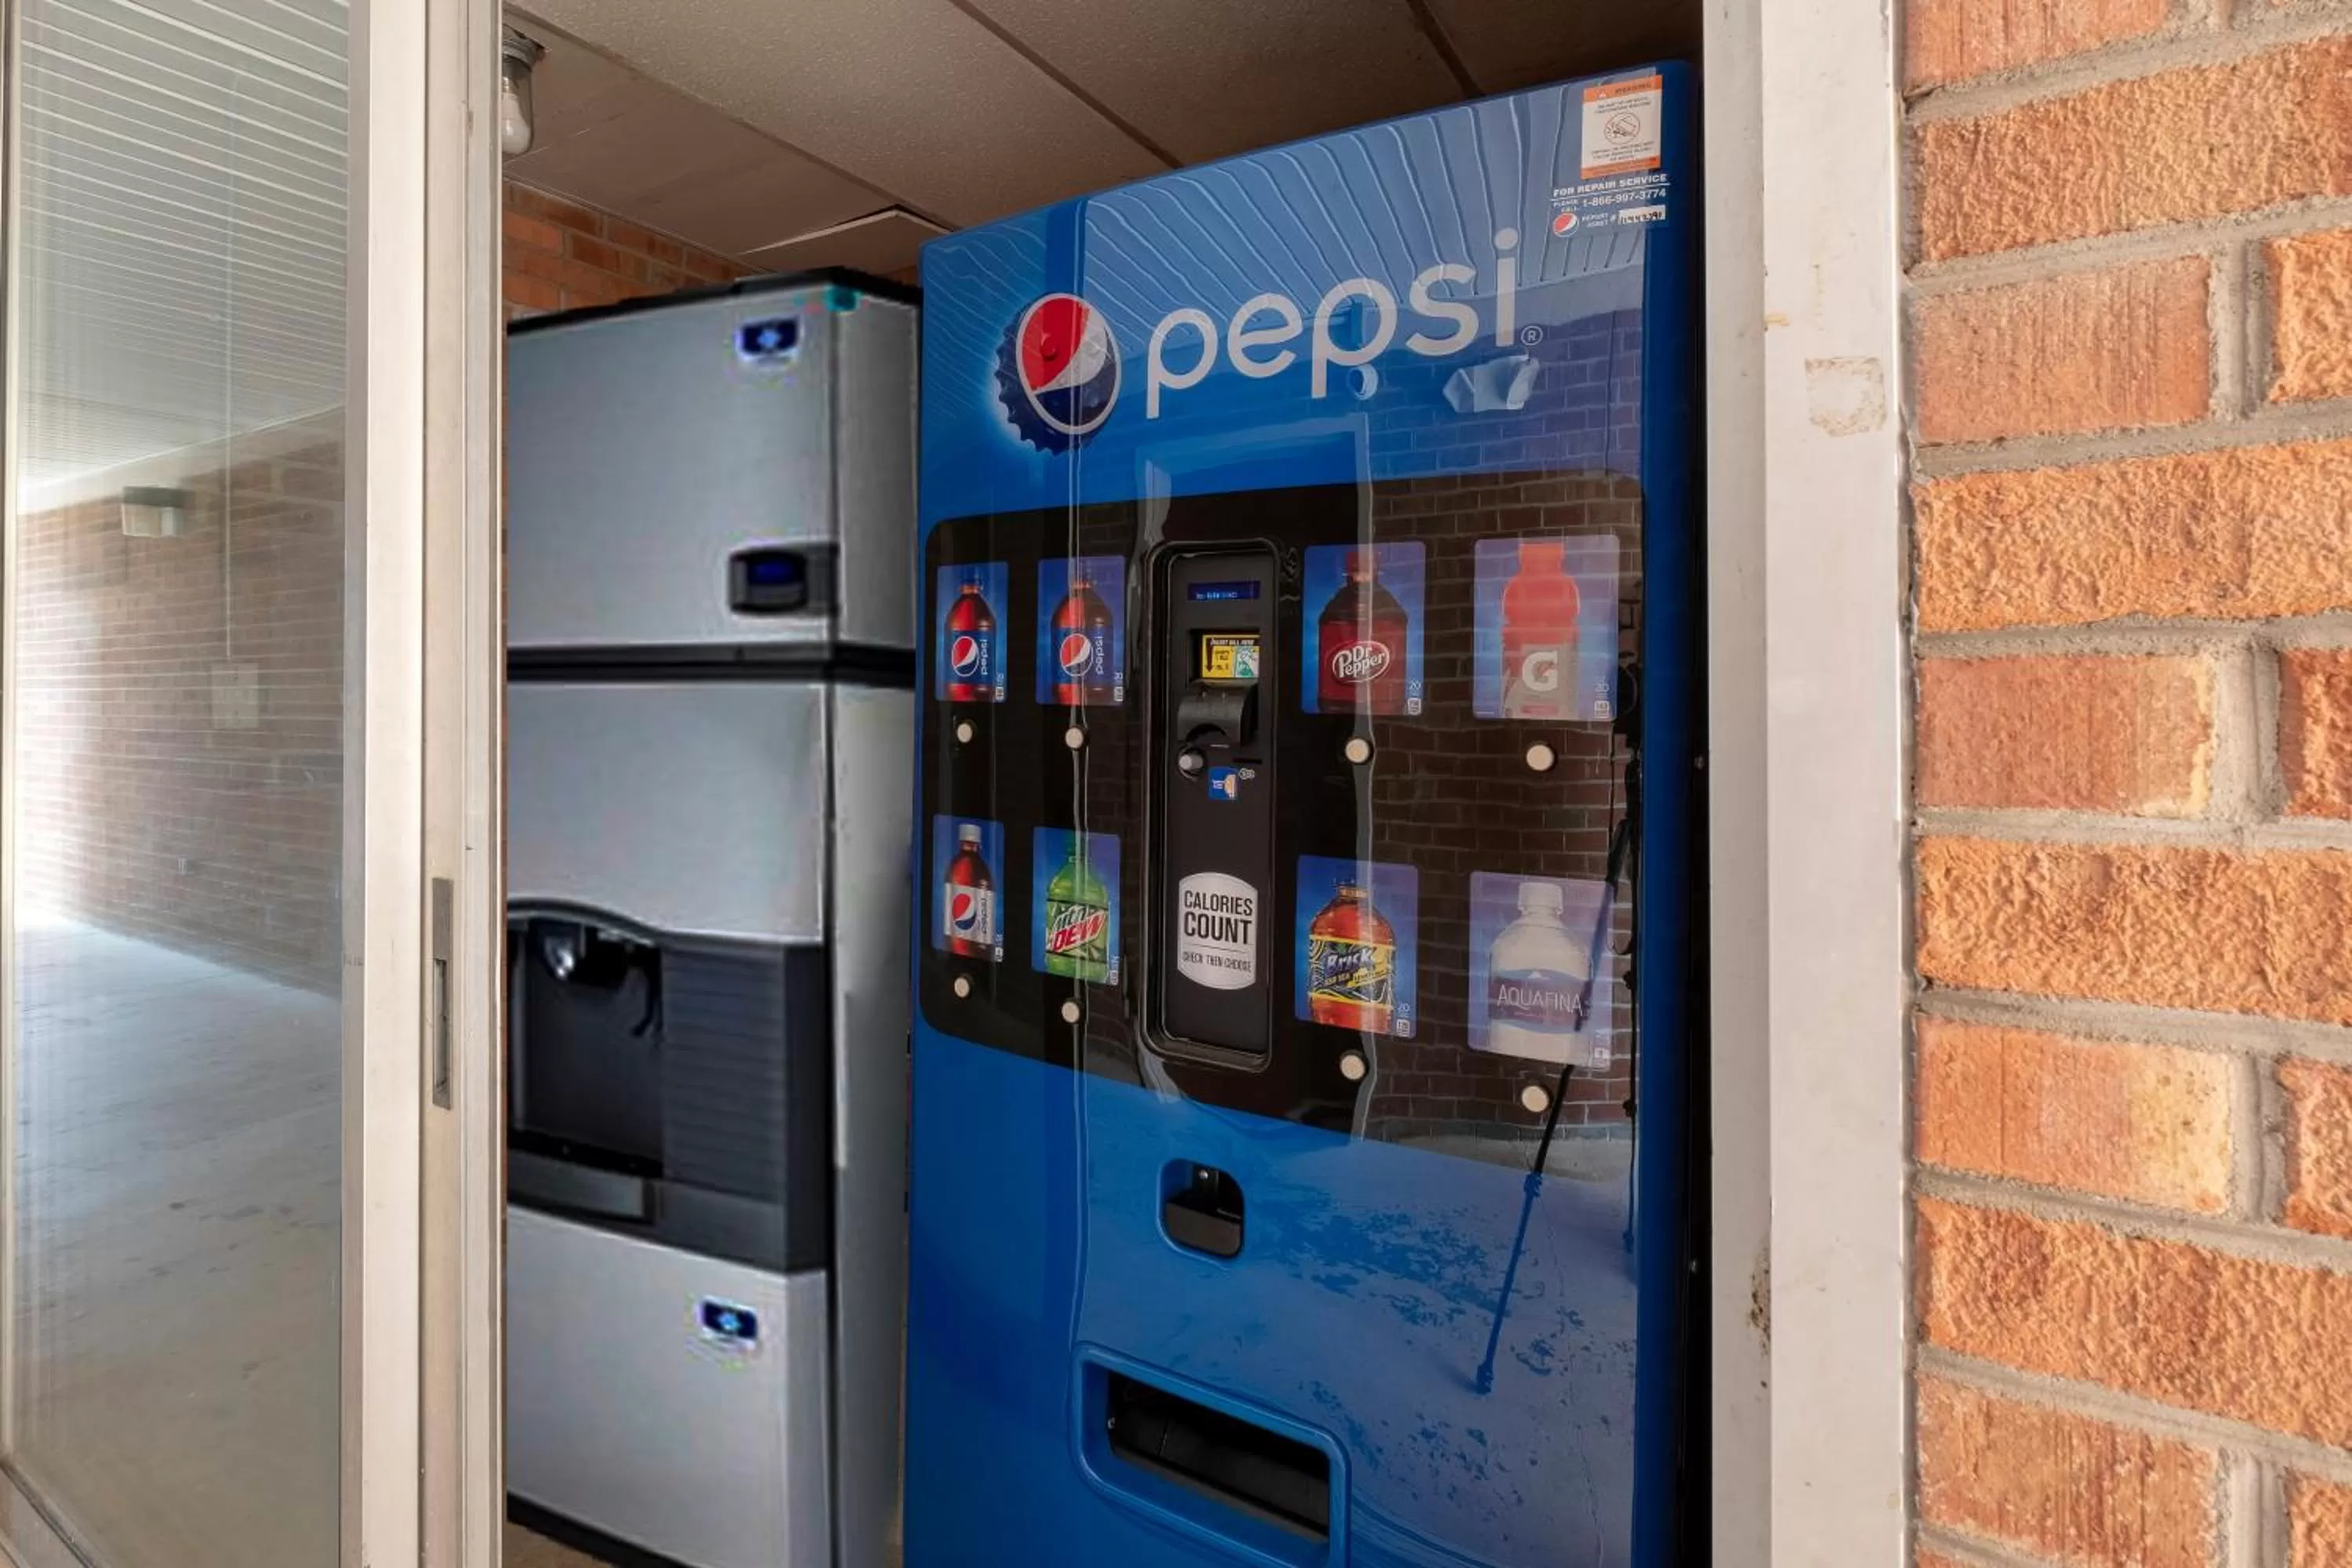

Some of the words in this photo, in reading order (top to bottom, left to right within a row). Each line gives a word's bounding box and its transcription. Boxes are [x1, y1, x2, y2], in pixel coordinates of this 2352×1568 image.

[1553, 187, 1575, 197] FOR
[1577, 181, 1616, 194] REPAIR
[1620, 174, 1668, 187] SERVICE
[1146, 228, 1521, 419] pepsi
[1094, 636, 1105, 675] pepsi
[1338, 650, 1385, 677] Pepper
[1353, 646, 1373, 661] Dr
[1522, 651, 1559, 691] G
[1184, 890, 1253, 916] CALORIES
[1054, 914, 1101, 953] DEW
[1184, 912, 1253, 945] COUNT
[1206, 955, 1222, 967] THEN
[1497, 984, 1582, 1016] AQUAFINA
